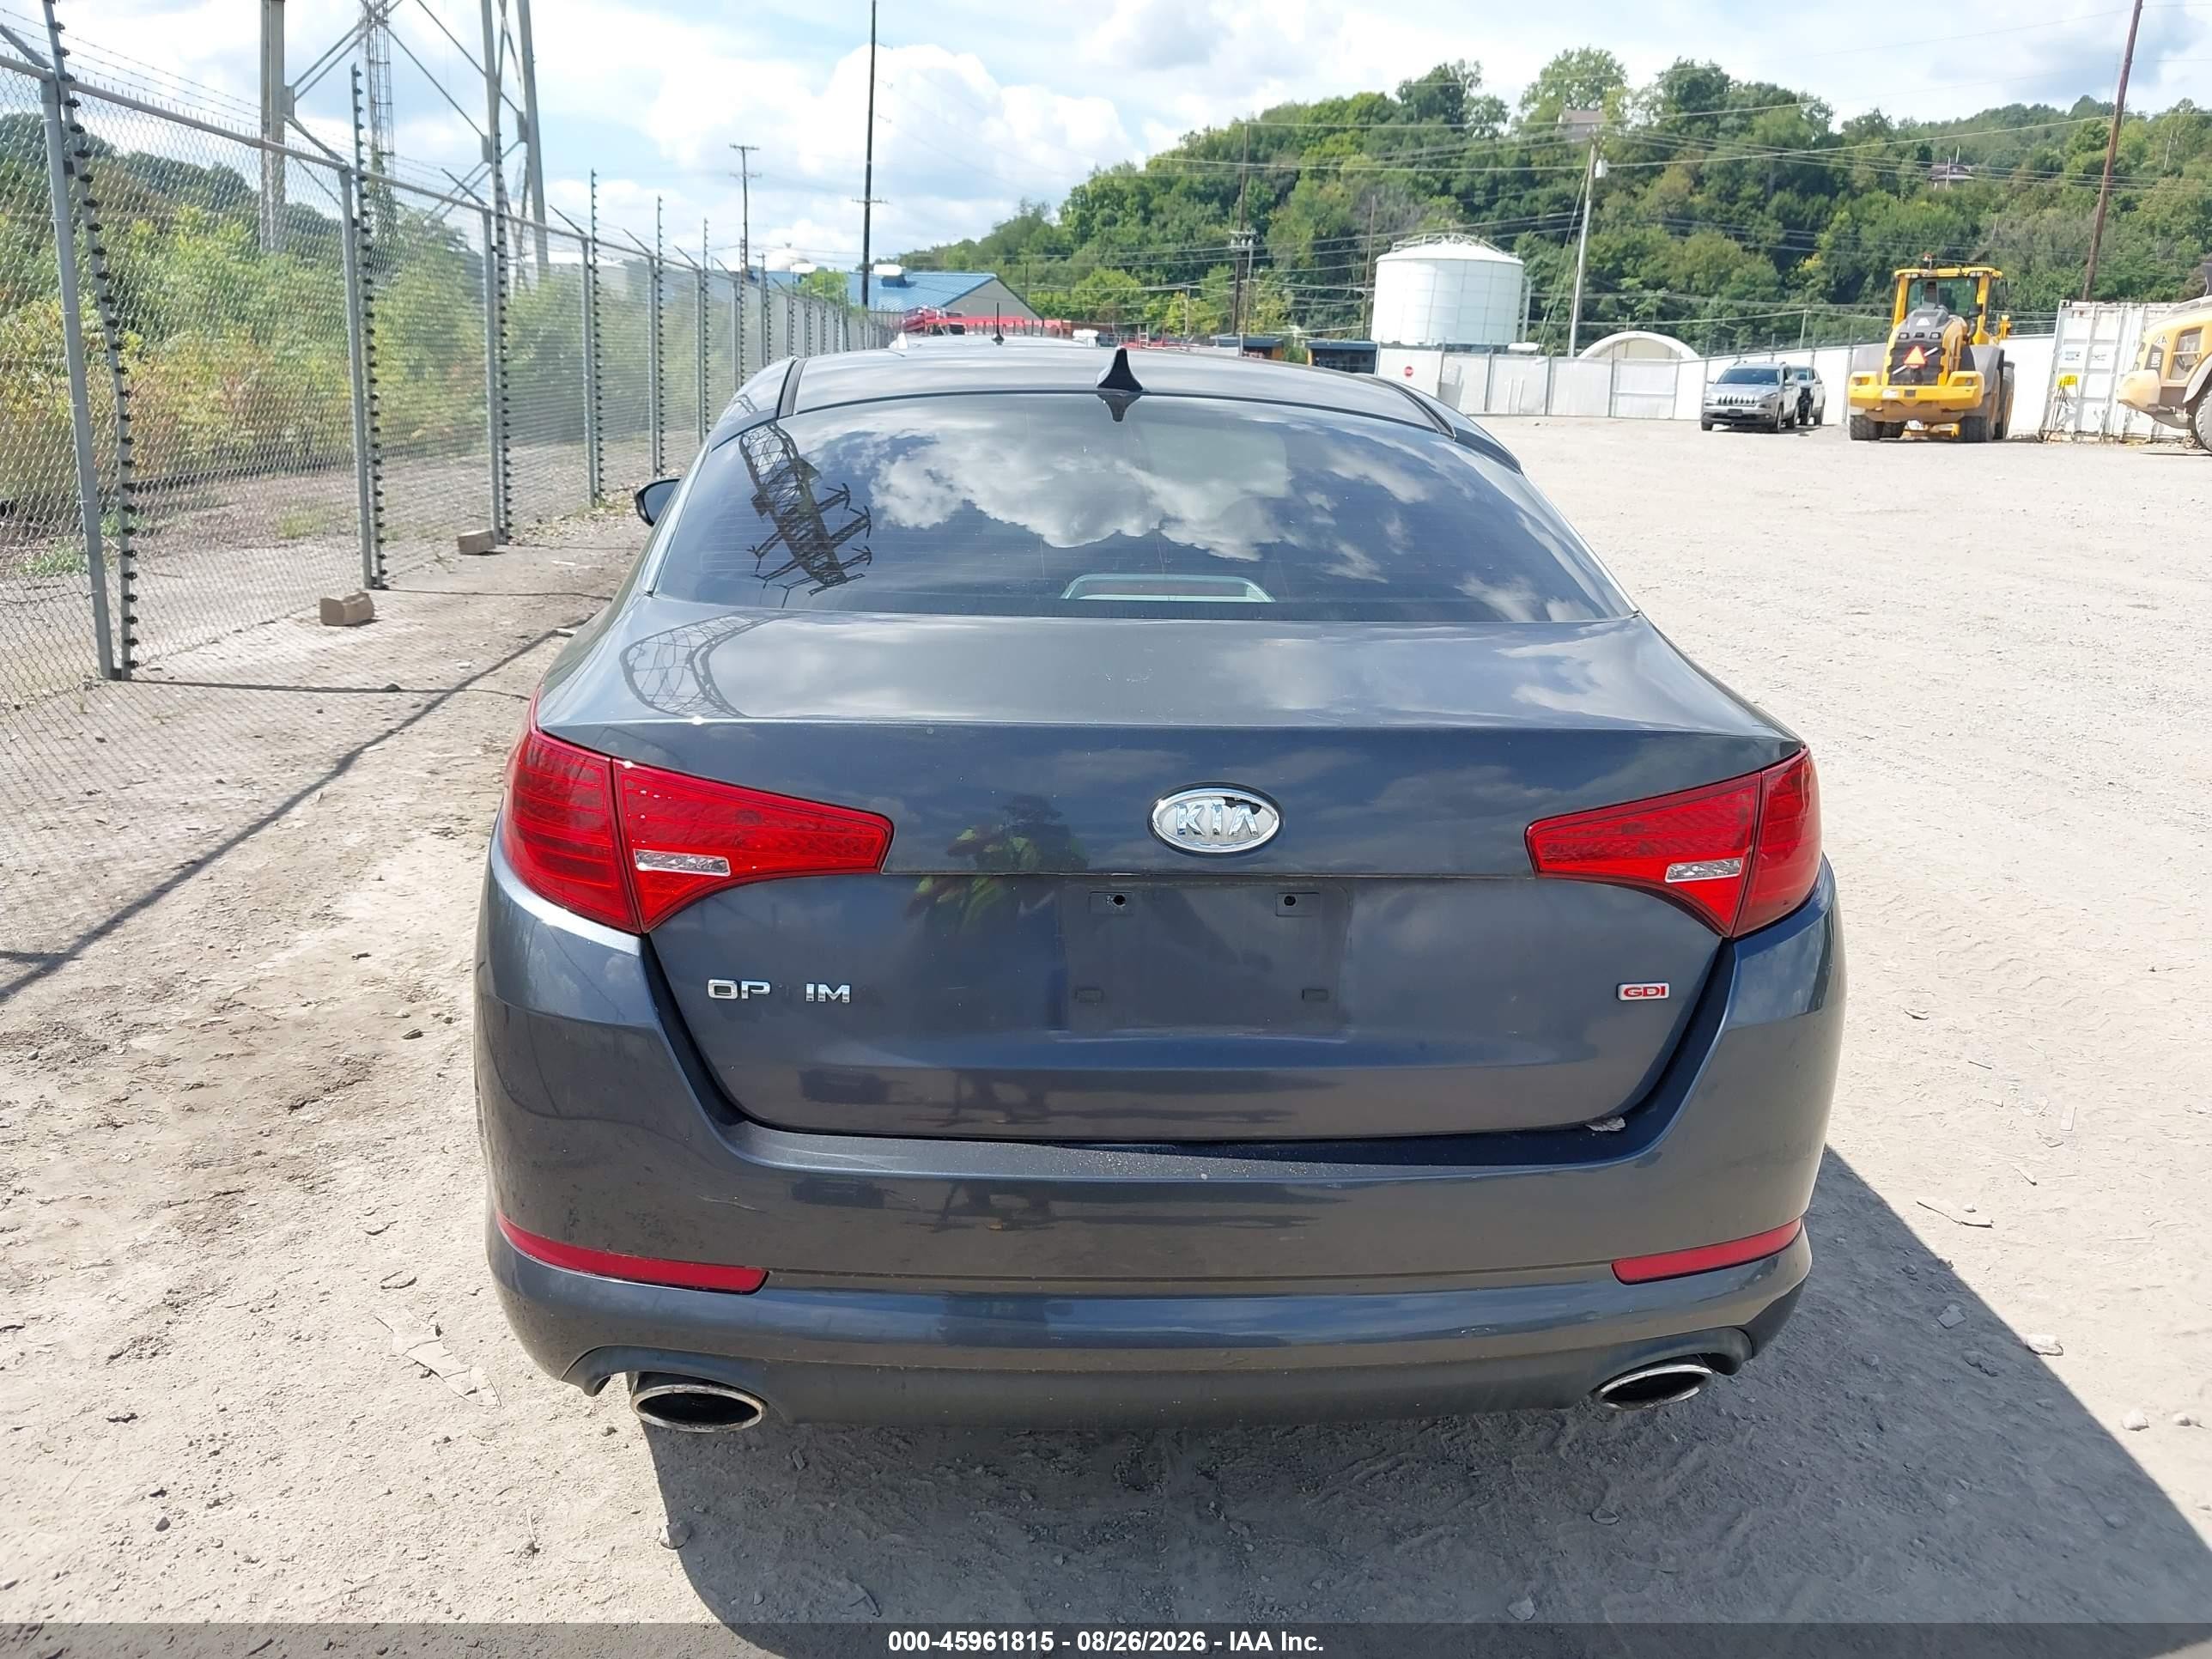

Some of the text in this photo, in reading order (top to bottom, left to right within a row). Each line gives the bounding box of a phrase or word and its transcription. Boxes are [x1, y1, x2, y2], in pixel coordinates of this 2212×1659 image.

[1175, 804, 1259, 837] KIA
[708, 978, 851, 1003] OP IM
[1624, 986, 1666, 998] GDI
